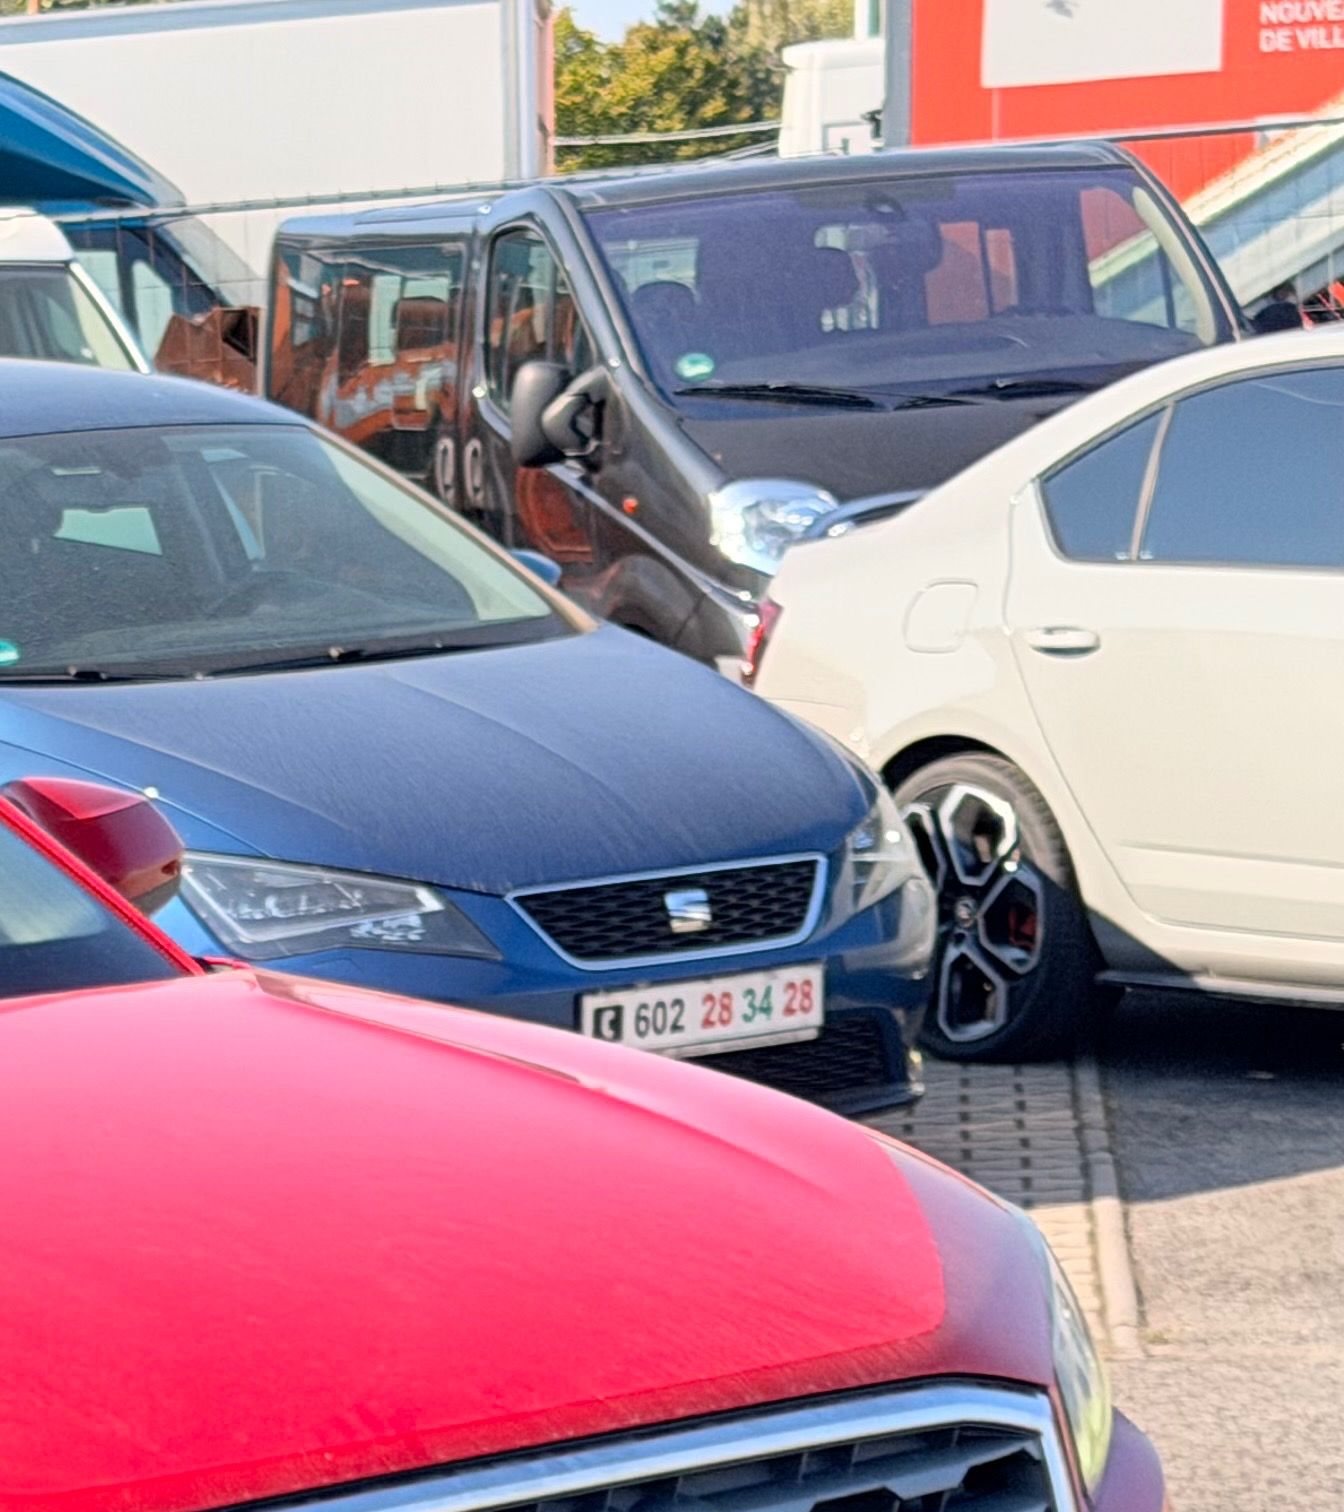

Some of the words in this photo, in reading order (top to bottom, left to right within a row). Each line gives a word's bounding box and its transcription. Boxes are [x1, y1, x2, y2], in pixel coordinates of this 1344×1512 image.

[1259, 27, 1294, 53] DE
[634, 999, 685, 1038] 602
[701, 992, 734, 1030] 28
[741, 984, 774, 1024] 34
[783, 979, 813, 1018] 28
